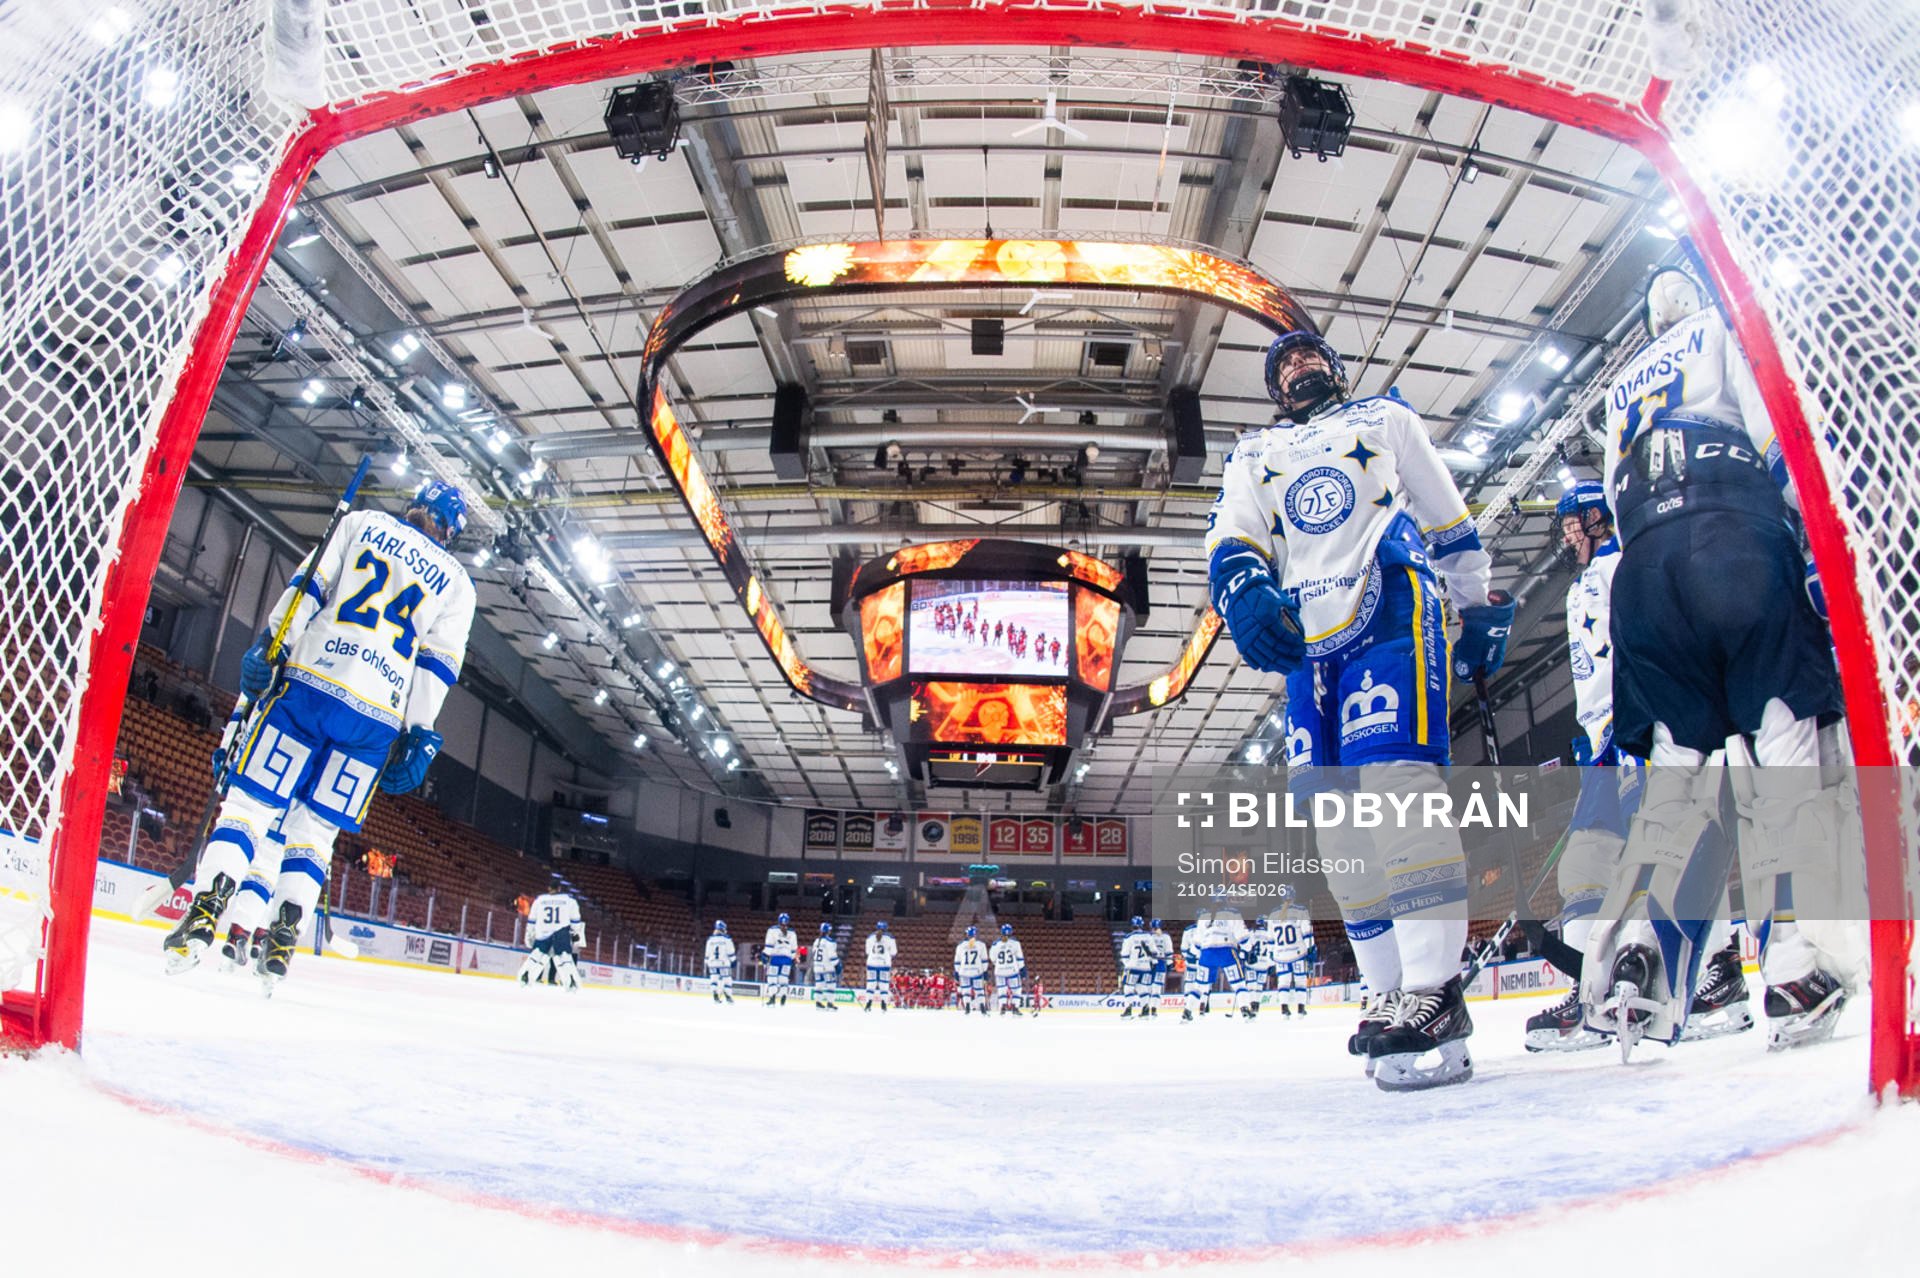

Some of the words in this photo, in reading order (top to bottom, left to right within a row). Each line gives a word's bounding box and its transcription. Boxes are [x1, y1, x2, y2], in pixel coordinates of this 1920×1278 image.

[1285, 481, 1303, 524] LEKSANDS
[1656, 496, 1683, 514] axis
[1302, 513, 1346, 534] ISHOCKEY
[360, 525, 451, 596] KARLSSON
[335, 548, 427, 661] 24
[324, 637, 359, 656] clas
[361, 648, 405, 691] ohlson
[1429, 669, 1441, 692] AB
[1341, 723, 1399, 748] MOSKOGEN
[845, 831, 873, 843] 2016
[953, 833, 979, 844] 1996
[995, 826, 1016, 843] 12
[1027, 826, 1049, 844] 35
[1100, 828, 1122, 845] 28
[1411, 894, 1444, 909] HEDIN
[543, 906, 560, 924] 31
[1274, 924, 1297, 946] 20
[964, 950, 978, 965] 17
[997, 949, 1014, 965] 93
[1500, 972, 1527, 992] NIEMI
[1432, 1013, 1451, 1035] CCM
